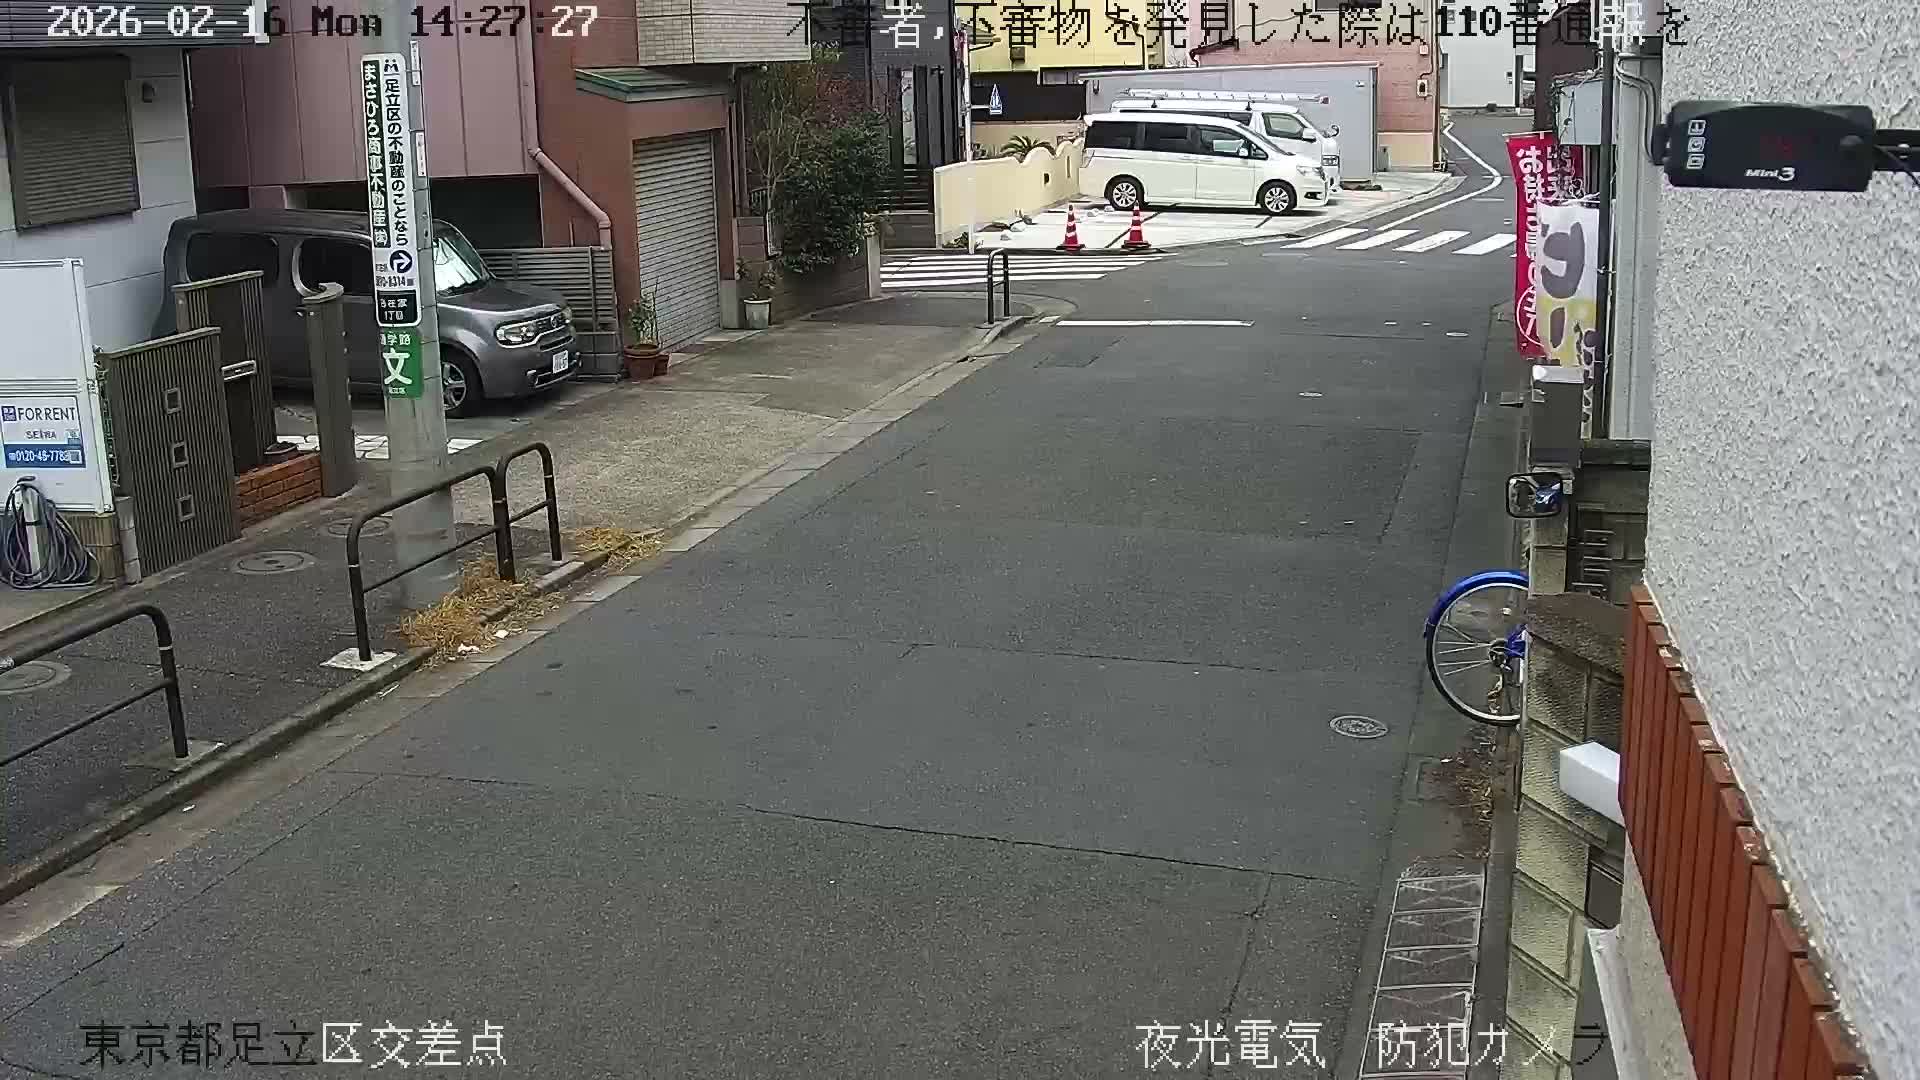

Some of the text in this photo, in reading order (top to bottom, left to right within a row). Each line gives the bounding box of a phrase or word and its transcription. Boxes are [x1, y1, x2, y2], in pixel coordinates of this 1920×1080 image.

[385, 79, 409, 246] 足立区の不動産のことなら
[382, 348, 413, 385] 文
[17, 407, 42, 421] FOR
[44, 407, 76, 421] RENT
